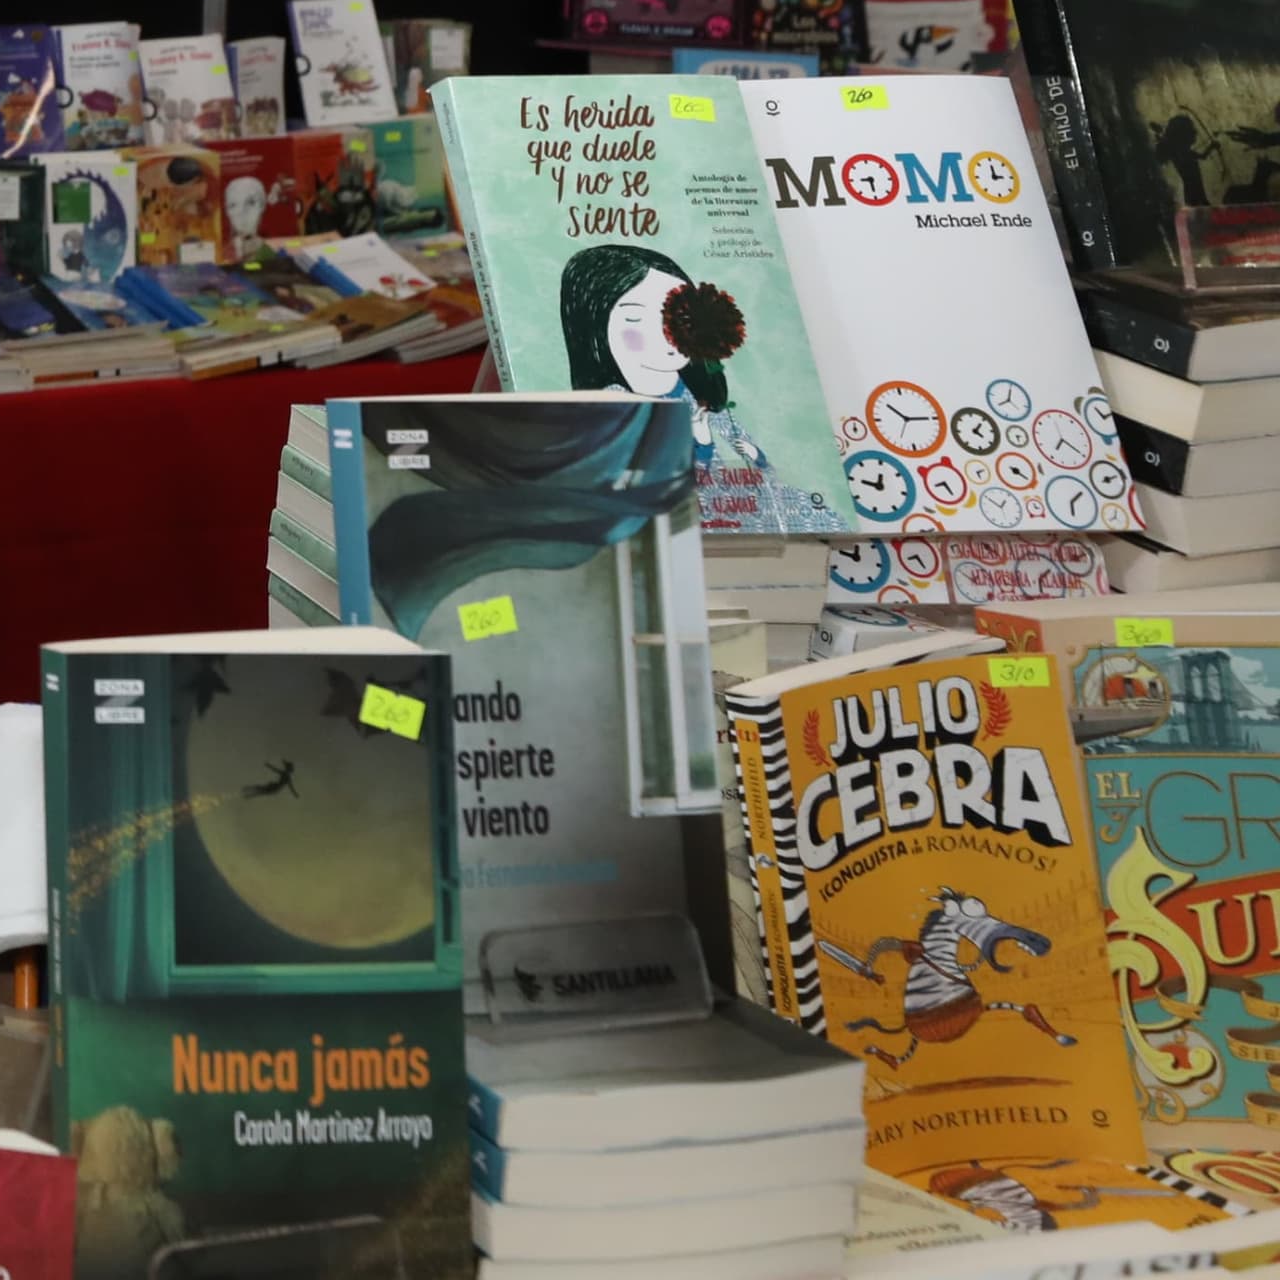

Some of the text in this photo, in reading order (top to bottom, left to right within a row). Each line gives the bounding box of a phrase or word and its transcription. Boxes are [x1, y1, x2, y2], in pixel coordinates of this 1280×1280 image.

[520, 95, 655, 132] Es herida
[528, 130, 656, 176] que duele
[576, 170, 614, 196] no
[621, 170, 650, 198] se
[766, 151, 1020, 208] MOMO
[567, 203, 660, 238] siente
[915, 213, 1032, 229] Michael Ende
[1001, 664, 1035, 683] 310
[453, 681, 521, 722] ando
[829, 675, 981, 760] JULIO
[457, 739, 555, 790] spierte
[746, 756, 767, 840] NORTHFIELD
[1095, 771, 1141, 800] EL
[462, 800, 550, 838] viento
[795, 742, 1073, 872] CEBRA
[1145, 770, 1280, 869] GR
[927, 834, 1058, 874] ROMANOS!
[551, 964, 677, 997] SANTILLANA
[172, 1033, 431, 1107] Nunca jamás
[234, 1108, 433, 1149] Carola Martínez Arroyo
[911, 1106, 1069, 1136] NORTHFIELD
